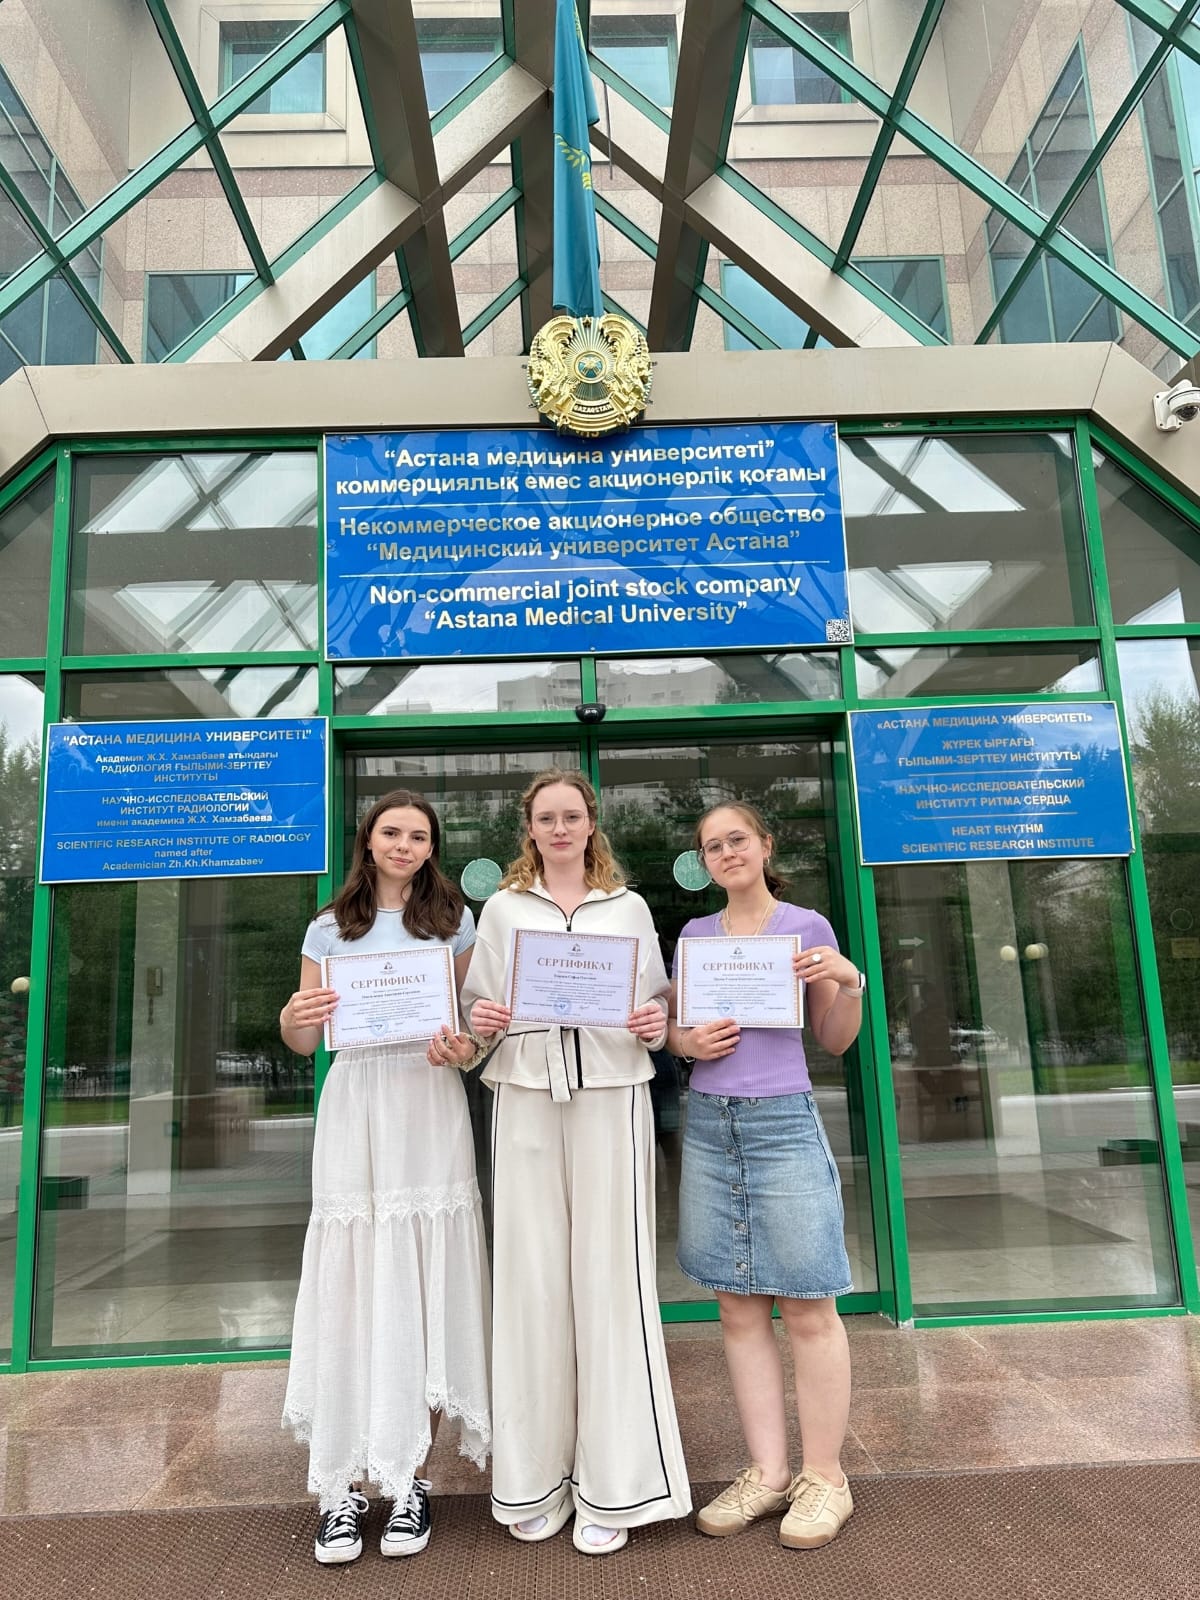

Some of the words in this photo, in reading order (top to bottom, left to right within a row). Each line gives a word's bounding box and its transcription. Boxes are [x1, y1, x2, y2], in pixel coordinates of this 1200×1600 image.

[384, 449, 479, 468] “Астана
[487, 449, 603, 468] медицина
[611, 440, 774, 467] университеті”
[336, 475, 519, 496] коммерциялық
[525, 475, 582, 489] емес
[588, 466, 733, 489] акционерлік
[739, 467, 826, 486] қоғамы
[339, 516, 541, 537] Некоммерческое
[548, 511, 702, 532] акционерное
[709, 506, 825, 527] общество
[367, 538, 542, 562] “Медицинский
[549, 536, 699, 560] университет
[706, 530, 800, 551] Астана”
[370, 580, 561, 604] Non-commercial
[566, 579, 619, 604] joint
[625, 577, 689, 597] stock
[695, 577, 801, 596] company
[424, 610, 518, 629] “Astana
[525, 605, 613, 627] Medical
[621, 601, 748, 624] University”
[877, 719, 930, 730] «АСТАНА
[932, 715, 999, 728] МЕДИЦИНА
[126, 732, 202, 745] МЕДИЦИНА
[95, 753, 144, 764] Академик
[171, 752, 225, 761] Хамзабаев
[1010, 751, 1081, 762] ИНСТИТУТЫ
[101, 763, 172, 774] РАДИОЛОГИЯ
[154, 773, 218, 783] ИНСТИТУТЫ
[899, 777, 1085, 795] НАУЧНО-ИССЛЕДОВАТЕЛЬСКИЙ
[102, 791, 269, 805] НАУЧНО-ИССЛЕДОВАТЕЛЬСКИЙ
[916, 798, 976, 809] ИНСТИТУТ
[980, 796, 1021, 807] РИТМА
[1023, 795, 1071, 806] СЕРДЦА
[120, 806, 174, 815] ИНСТИТУТ
[177, 803, 250, 813] РАДИОЛОГИИ
[97, 819, 128, 827] имени
[131, 817, 185, 827] академика
[212, 814, 273, 823] Хамзабаева
[952, 825, 991, 836] HEART
[994, 824, 1043, 834] RHYTHM
[56, 840, 113, 850] SCIENTIFIC
[116, 838, 174, 848] RESEARCH
[176, 836, 229, 846] INSTITUTE
[232, 835, 247, 844] OF
[249, 832, 311, 843] RADIOLOGY
[902, 842, 967, 854] SCIENTIFIC
[969, 839, 1034, 851] RESEARCH
[1037, 837, 1095, 849] INSTITUTE
[154, 848, 188, 858] named
[190, 848, 213, 857] after
[102, 860, 166, 871] Academician
[168, 857, 264, 868] Zh.Kh.Khamzabaev
[537, 957, 613, 971] СЕРТИФИКАТ
[702, 961, 775, 971] СЕРТИФИКАТ
[351, 974, 427, 990] СЕРТИФИКАТ
